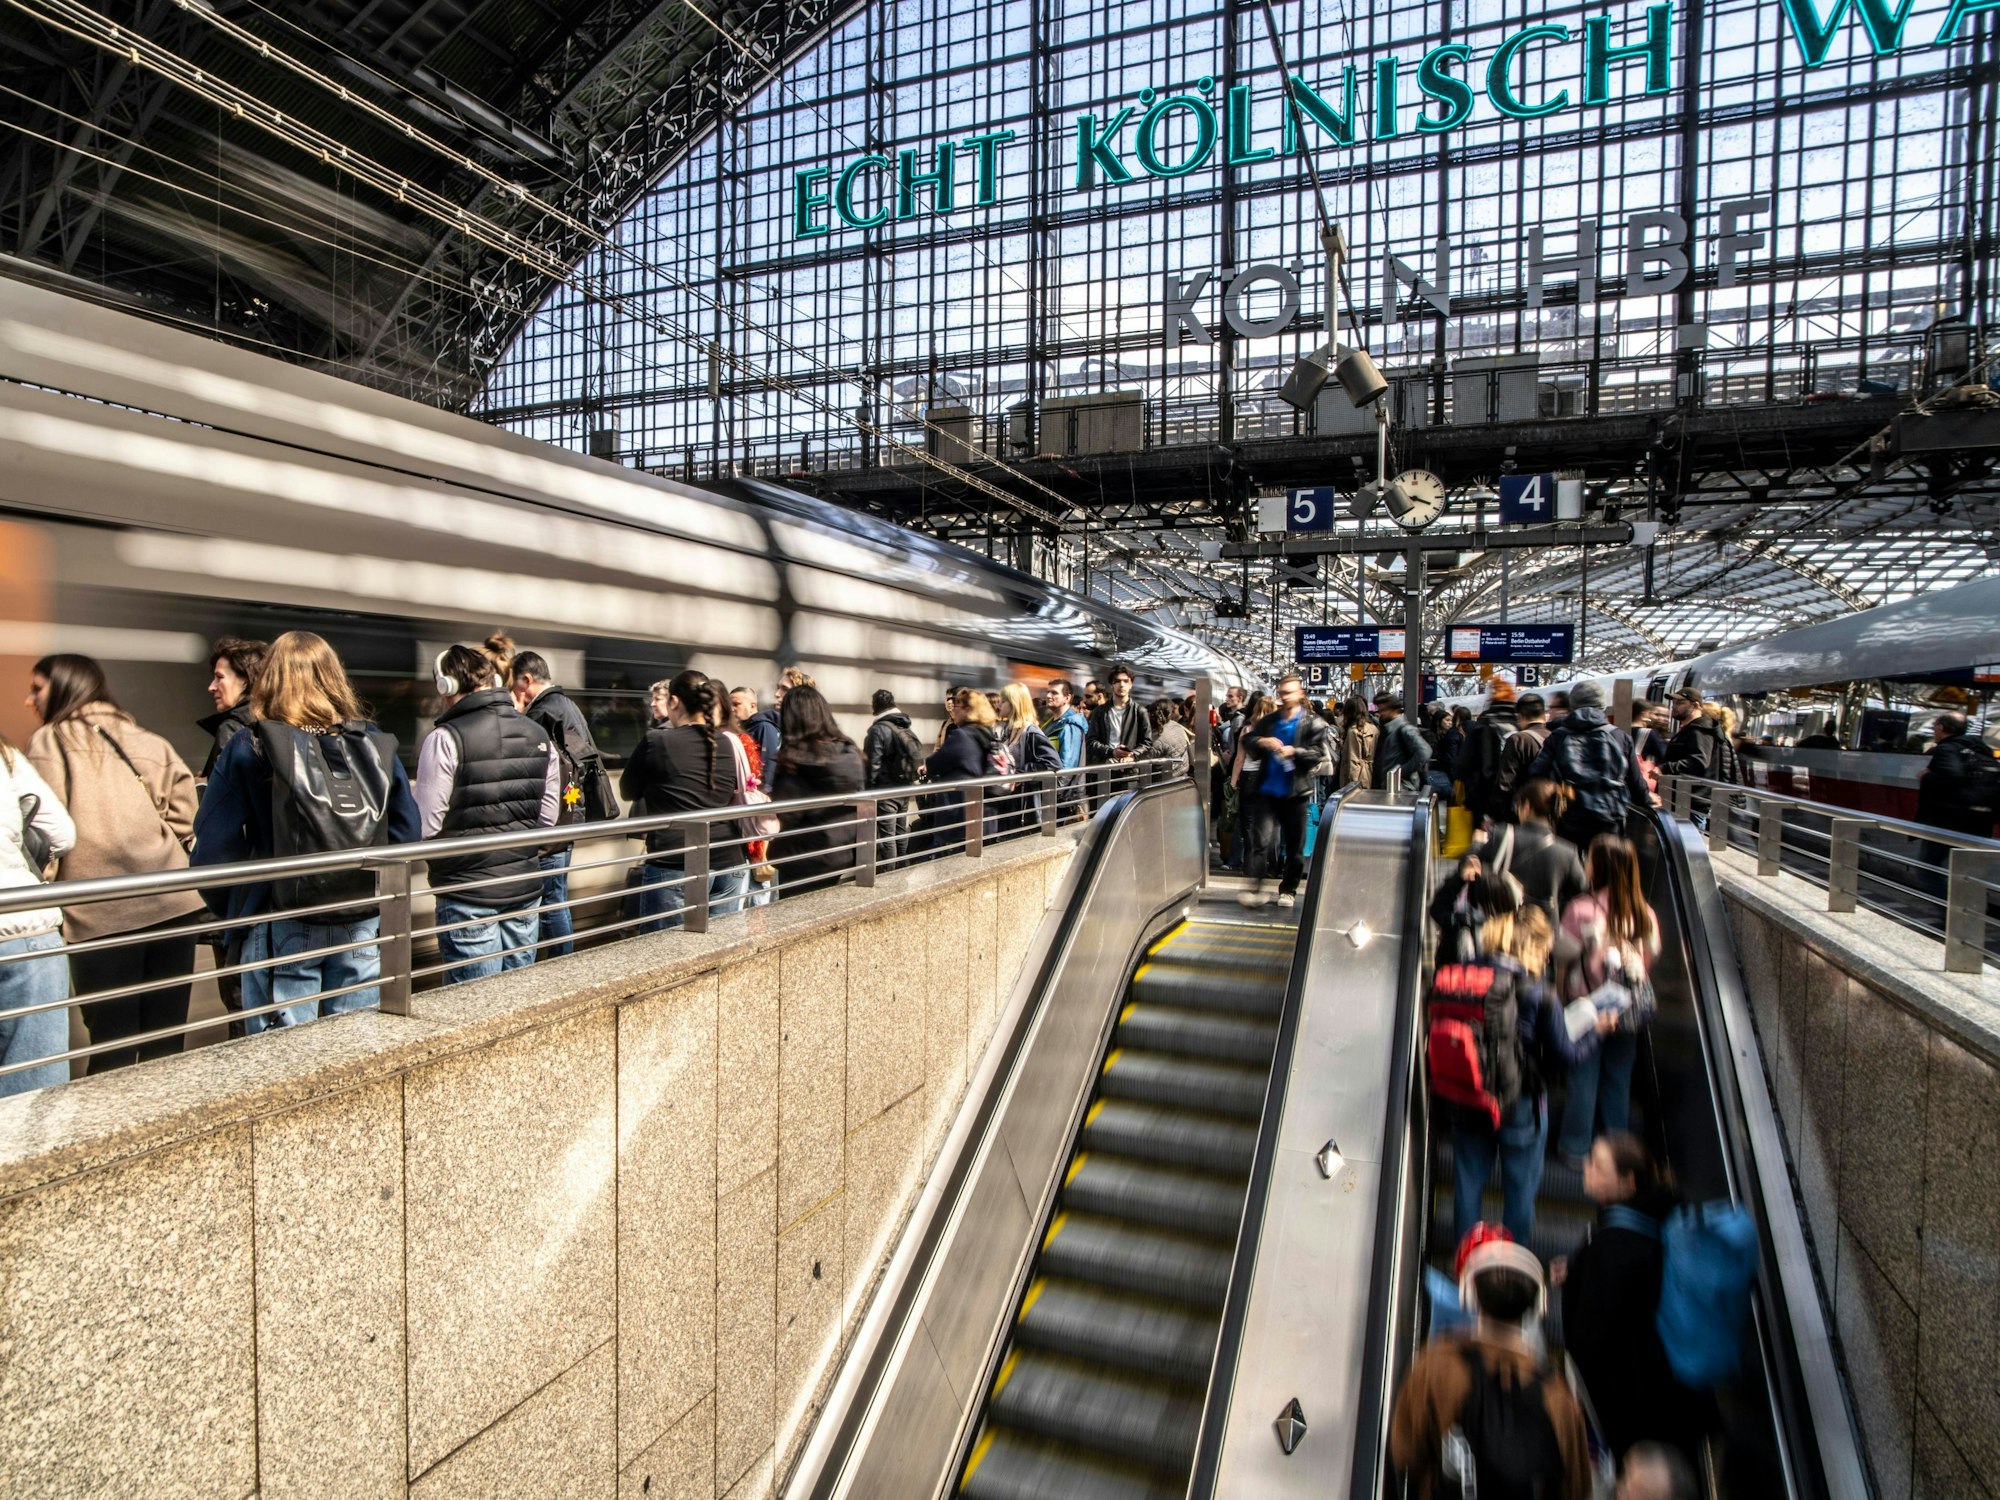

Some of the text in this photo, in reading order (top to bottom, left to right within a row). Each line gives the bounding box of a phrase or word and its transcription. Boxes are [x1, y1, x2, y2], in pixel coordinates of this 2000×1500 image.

[795, 129, 1015, 239] ECHT
[1076, 2, 1674, 190] KÖLNISCH
[1527, 199, 1770, 308] HBF
[1293, 489, 1316, 524] 5
[1519, 475, 1545, 512] 4
[1311, 667, 1322, 682] B
[1524, 667, 1537, 682] B
